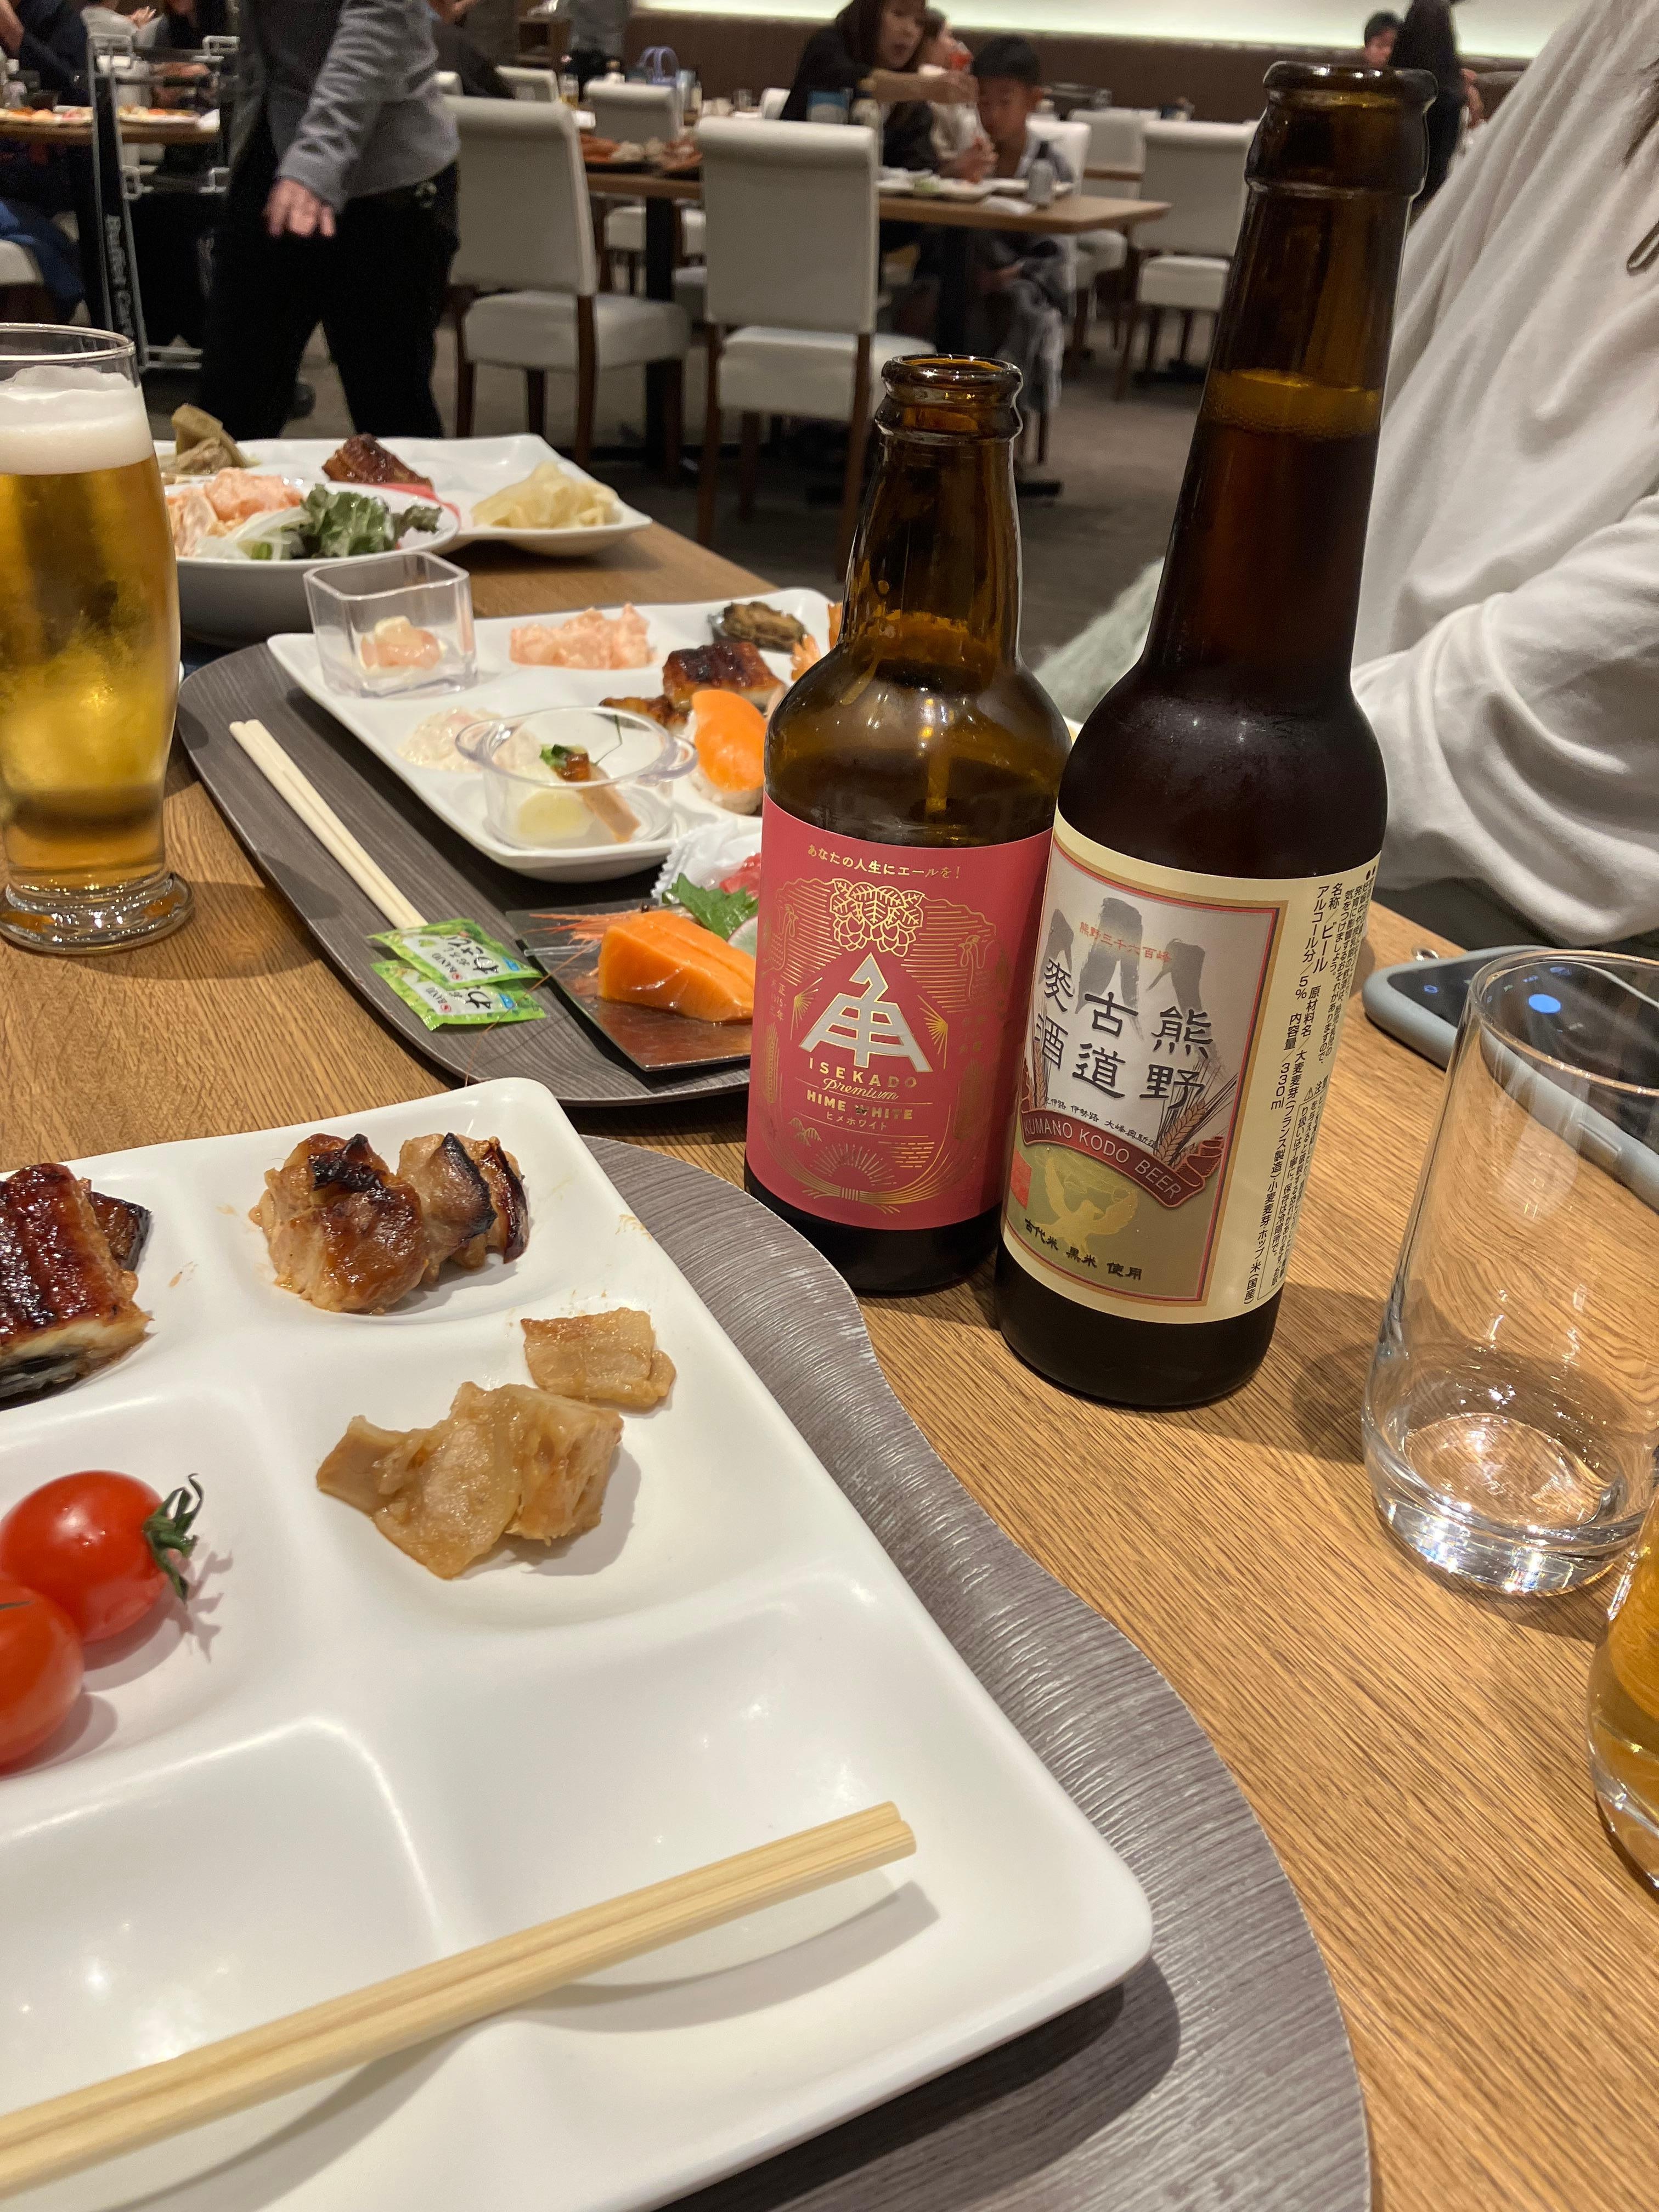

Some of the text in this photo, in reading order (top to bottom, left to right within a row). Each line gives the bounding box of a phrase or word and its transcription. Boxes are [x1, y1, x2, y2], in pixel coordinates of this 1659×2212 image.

[809, 1057, 917, 1088] ISEKADO
[807, 1089, 913, 1120] HIME WHITE
[826, 1111, 887, 1130] ヒメホワイト
[1024, 1118, 1182, 1199] KUMANO KODO BEER
[1025, 1218, 1059, 1251] 古代米
[1107, 1262, 1142, 1280] 使用
